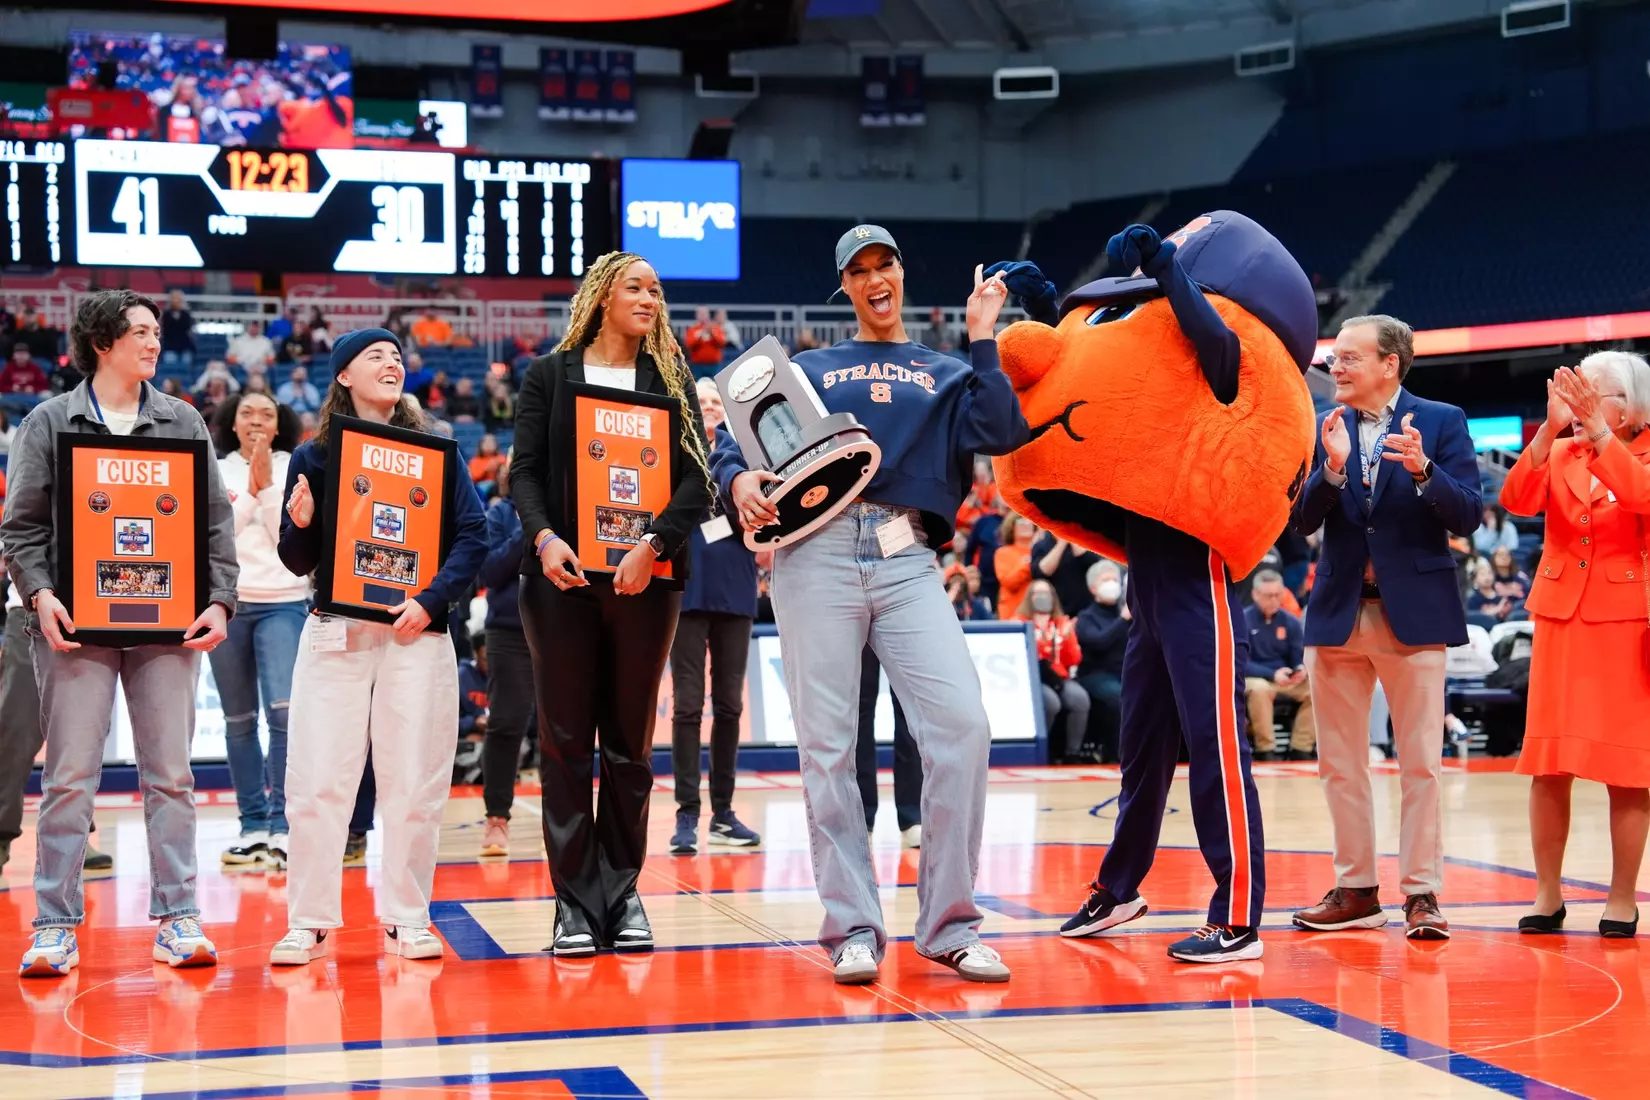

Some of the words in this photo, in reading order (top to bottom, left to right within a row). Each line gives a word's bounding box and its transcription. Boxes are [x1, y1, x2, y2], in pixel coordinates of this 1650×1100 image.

[226, 151, 309, 193] 12:23
[112, 176, 160, 235] 41
[371, 186, 424, 244] 30
[854, 227, 871, 239] LA
[823, 363, 938, 394] SYRACUSE
[870, 383, 892, 403] S
[598, 409, 646, 438] 'CUSE
[101, 460, 164, 485] 'CUSE
[365, 445, 417, 478] 'CUSE
[786, 441, 829, 473] RUNNER-UP
